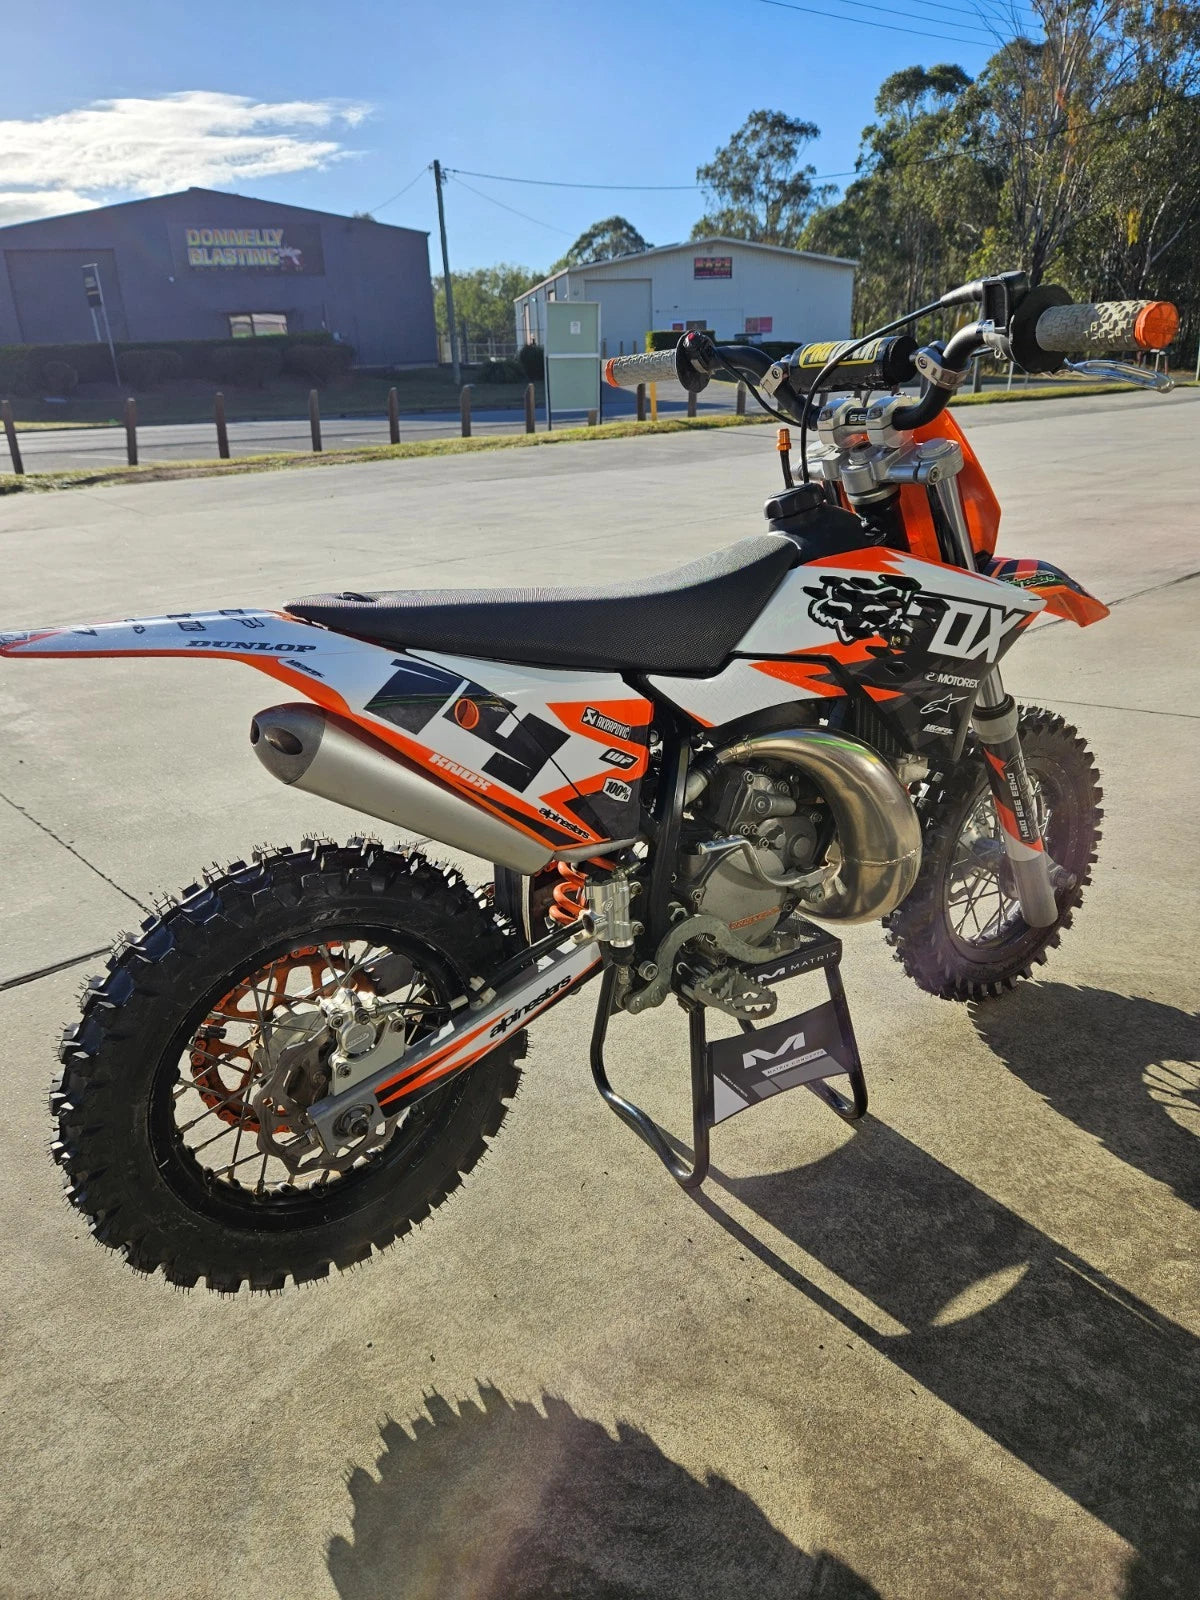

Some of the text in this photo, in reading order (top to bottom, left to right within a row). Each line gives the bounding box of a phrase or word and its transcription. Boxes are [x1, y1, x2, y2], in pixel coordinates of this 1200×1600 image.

[186, 229, 283, 246] DONNELLY
[188, 247, 280, 266] BLASTING
[186, 640, 317, 653] DUNLOP
[937, 673, 980, 689] MOTOREX
[428, 753, 493, 790] KNOX
[605, 781, 629, 800] 100%
[539, 807, 590, 839] alpinestars
[790, 950, 838, 971] MATRIX
[489, 975, 571, 1038] alpinestars
